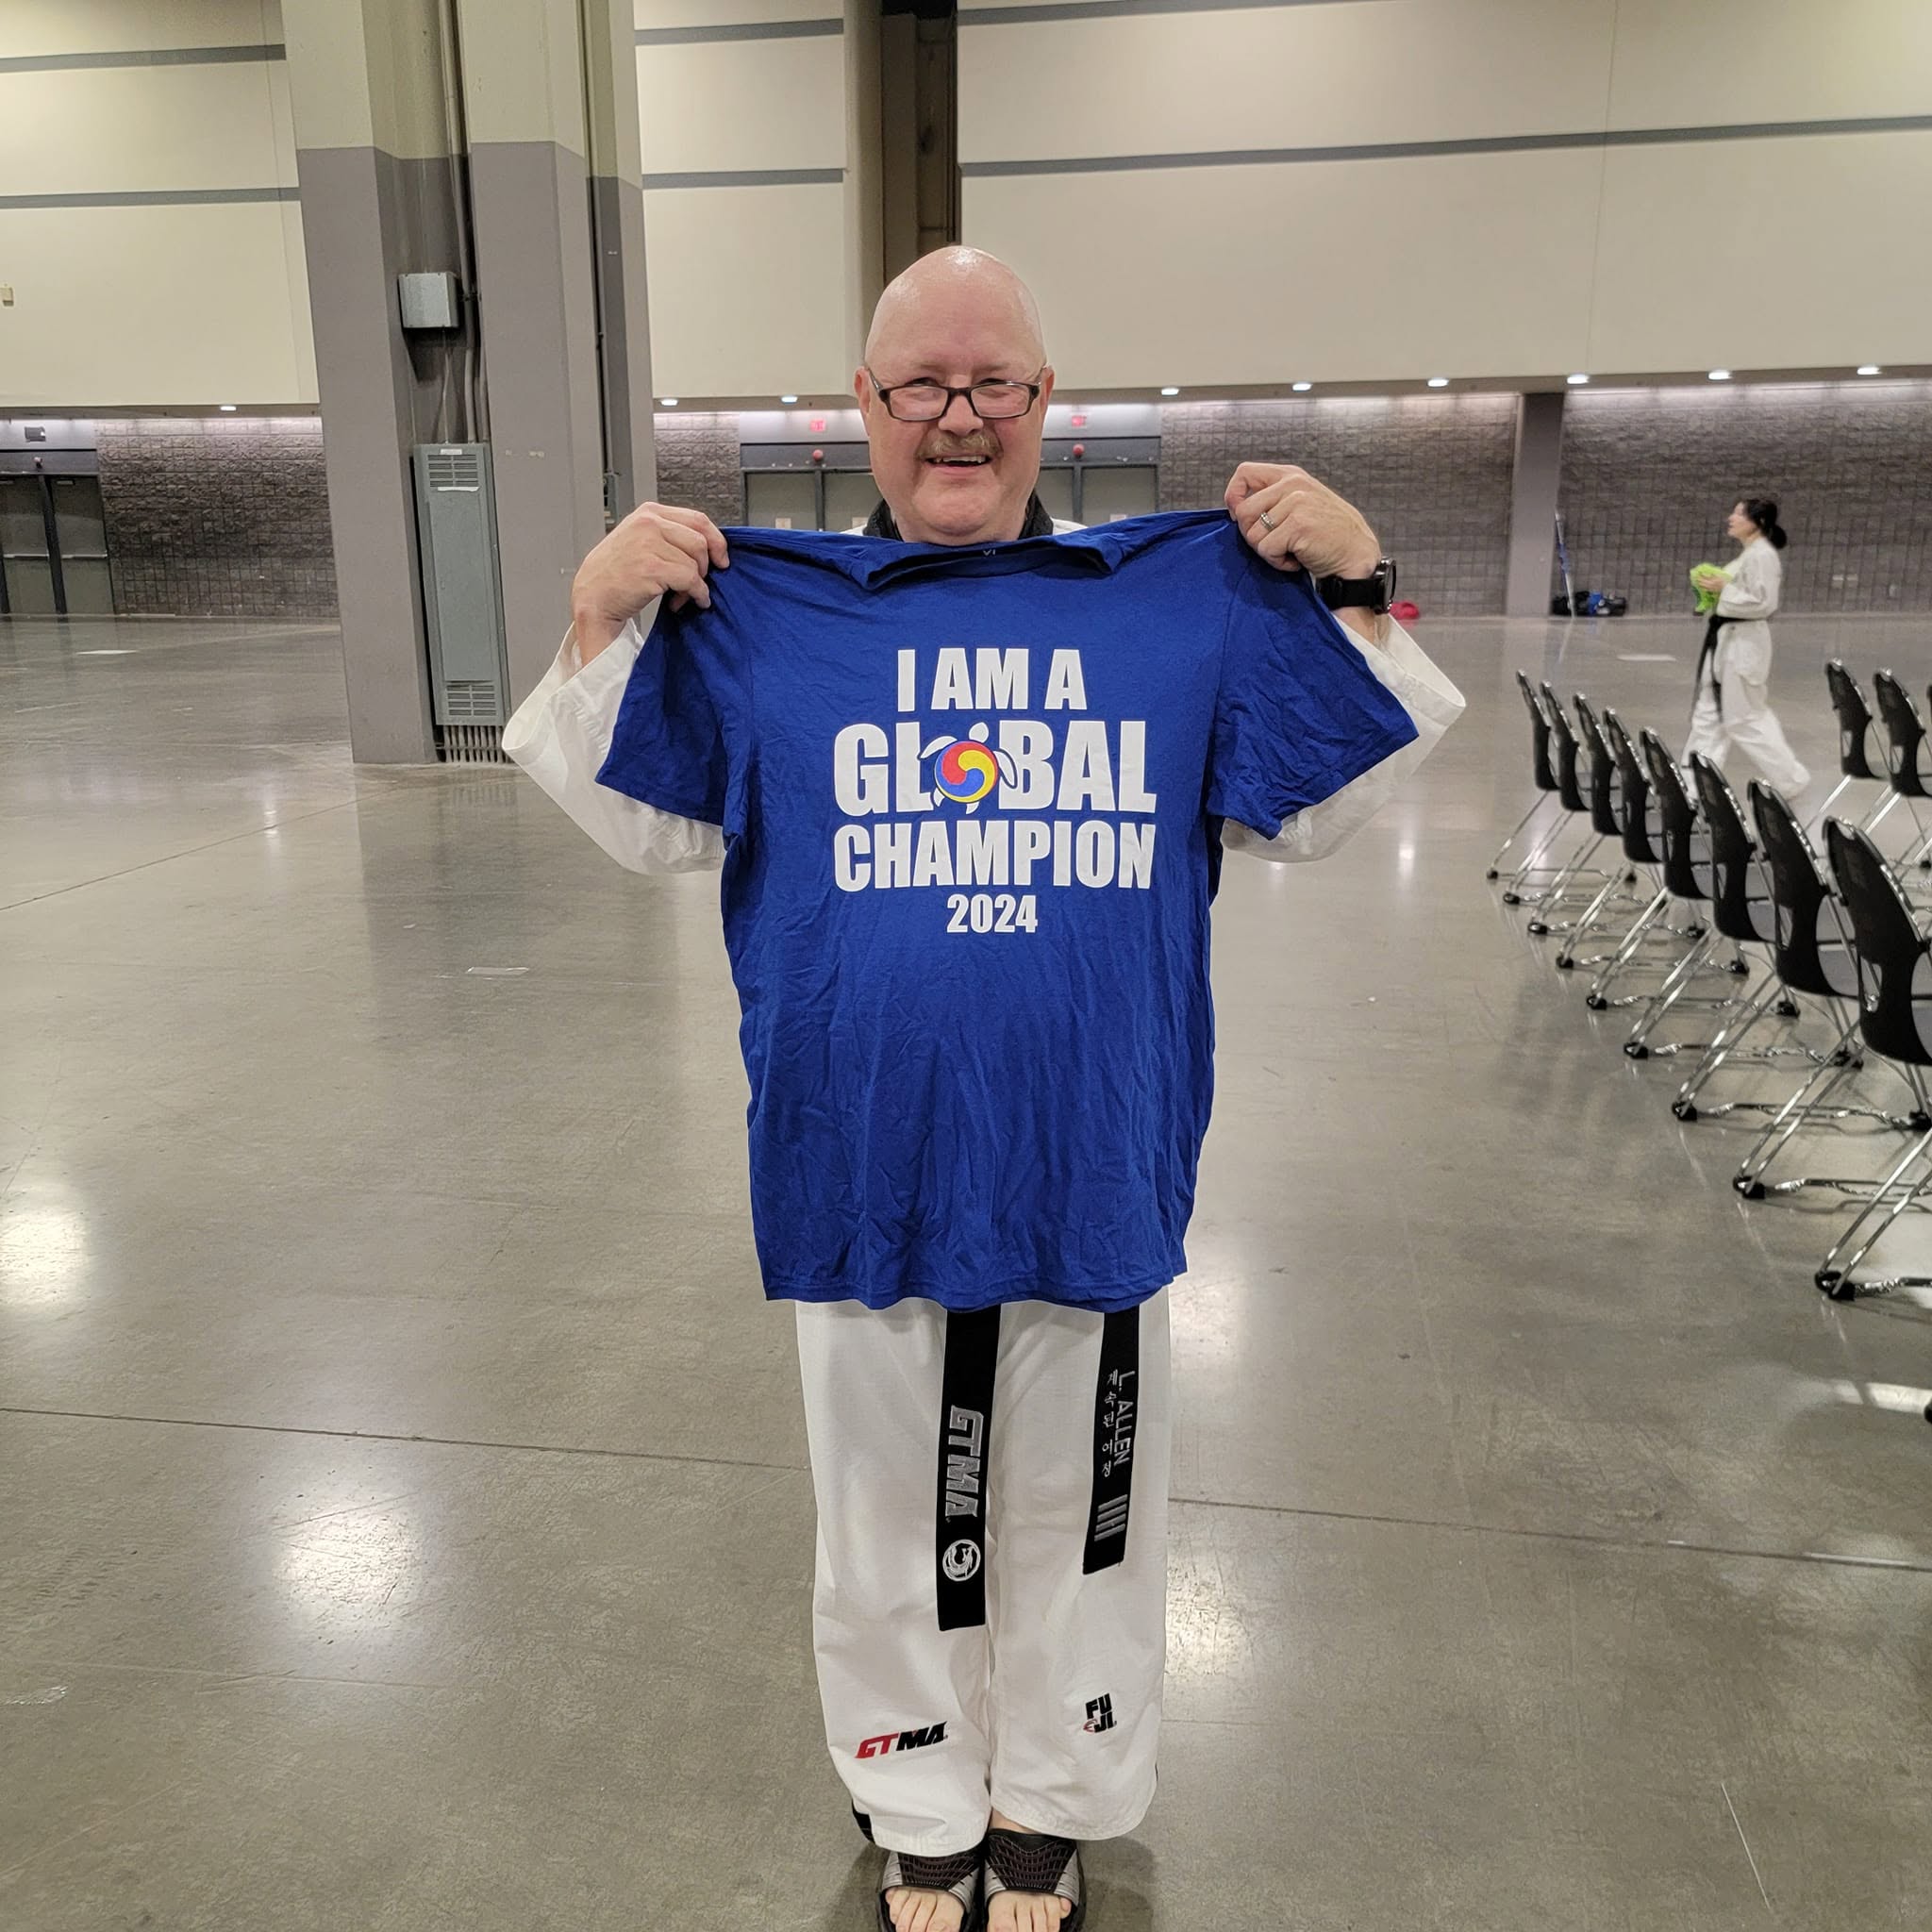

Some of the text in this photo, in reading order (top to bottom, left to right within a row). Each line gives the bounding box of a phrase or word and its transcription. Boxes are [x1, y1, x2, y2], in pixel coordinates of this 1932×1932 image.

[897, 647, 1088, 711] I AM A
[833, 720, 1158, 817] GLOBAL
[833, 820, 1157, 892] CHAMPION
[945, 893, 1039, 933] 2024
[1113, 1371, 1136, 1467] L. ALLEN
[944, 1404, 984, 1518] GTMA
[854, 1721, 948, 1759] GTMA
